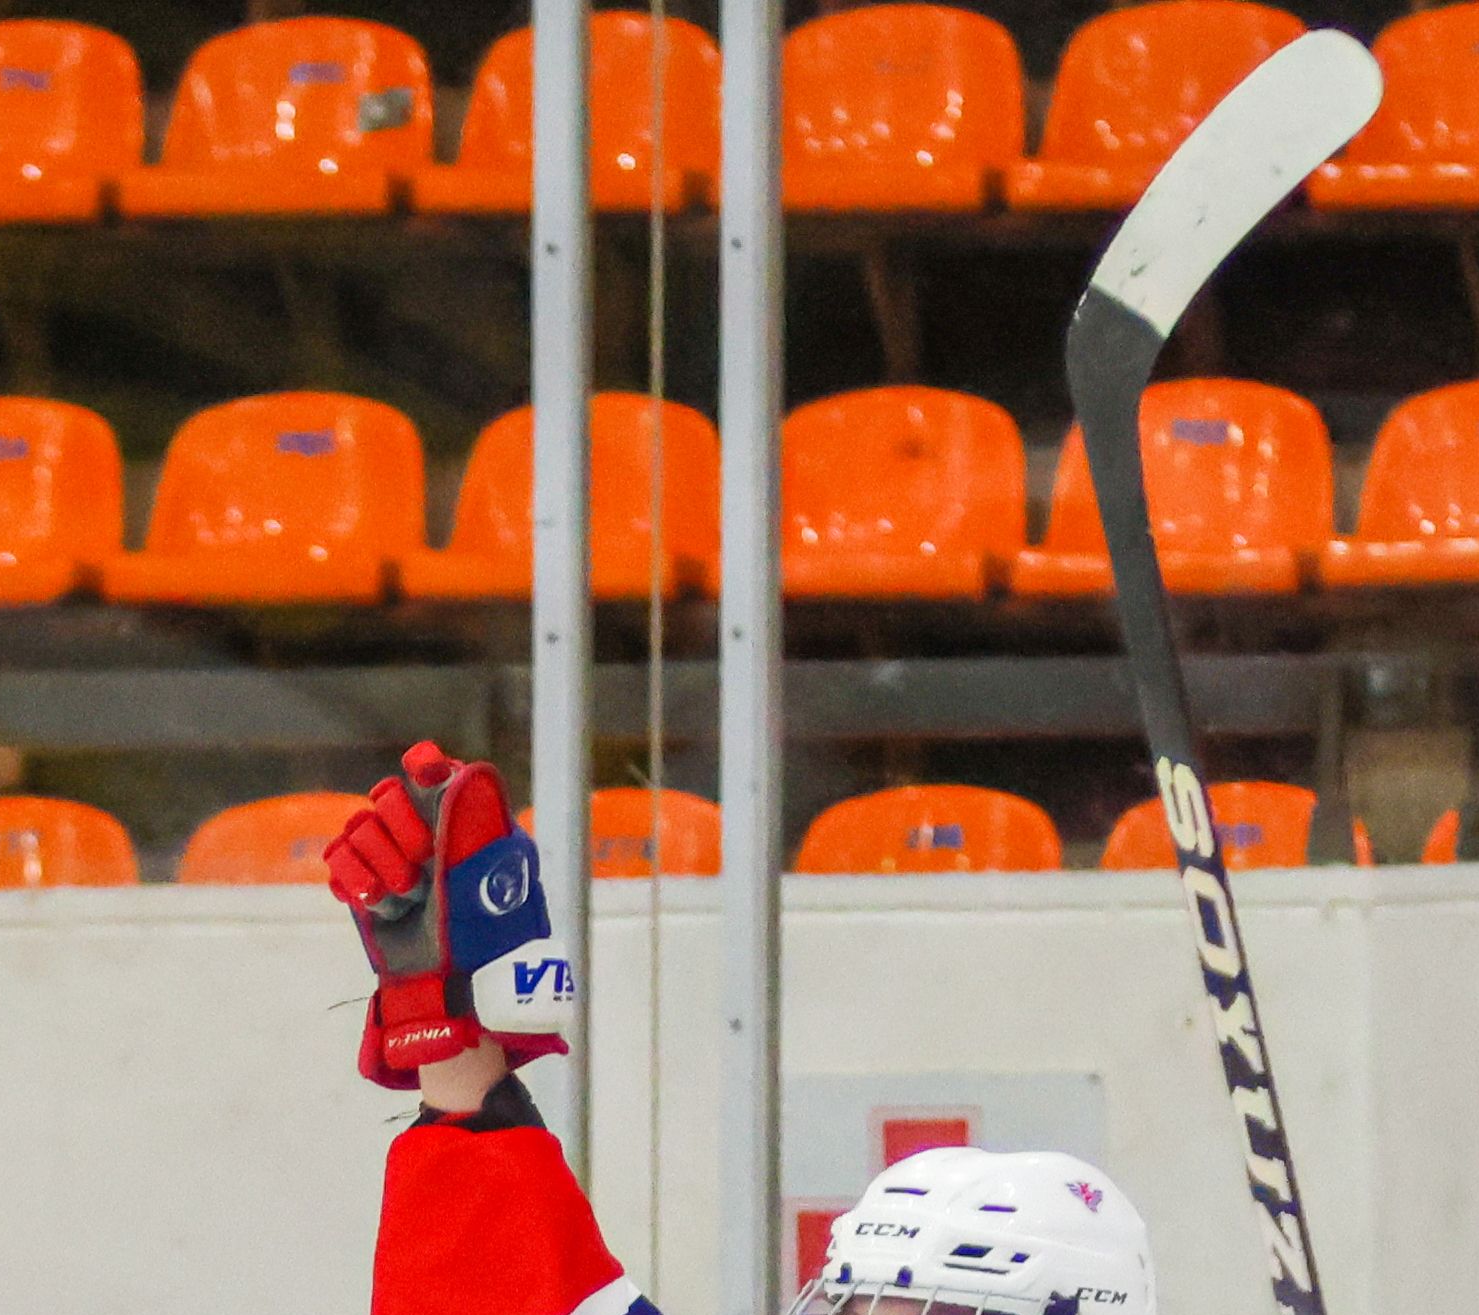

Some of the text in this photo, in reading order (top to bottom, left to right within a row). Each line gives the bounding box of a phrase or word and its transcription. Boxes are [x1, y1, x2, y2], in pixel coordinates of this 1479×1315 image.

[1155, 756, 1313, 1294] SOYUZ
[855, 1222, 920, 1240] CCM
[1075, 1287, 1128, 1305] CCM
